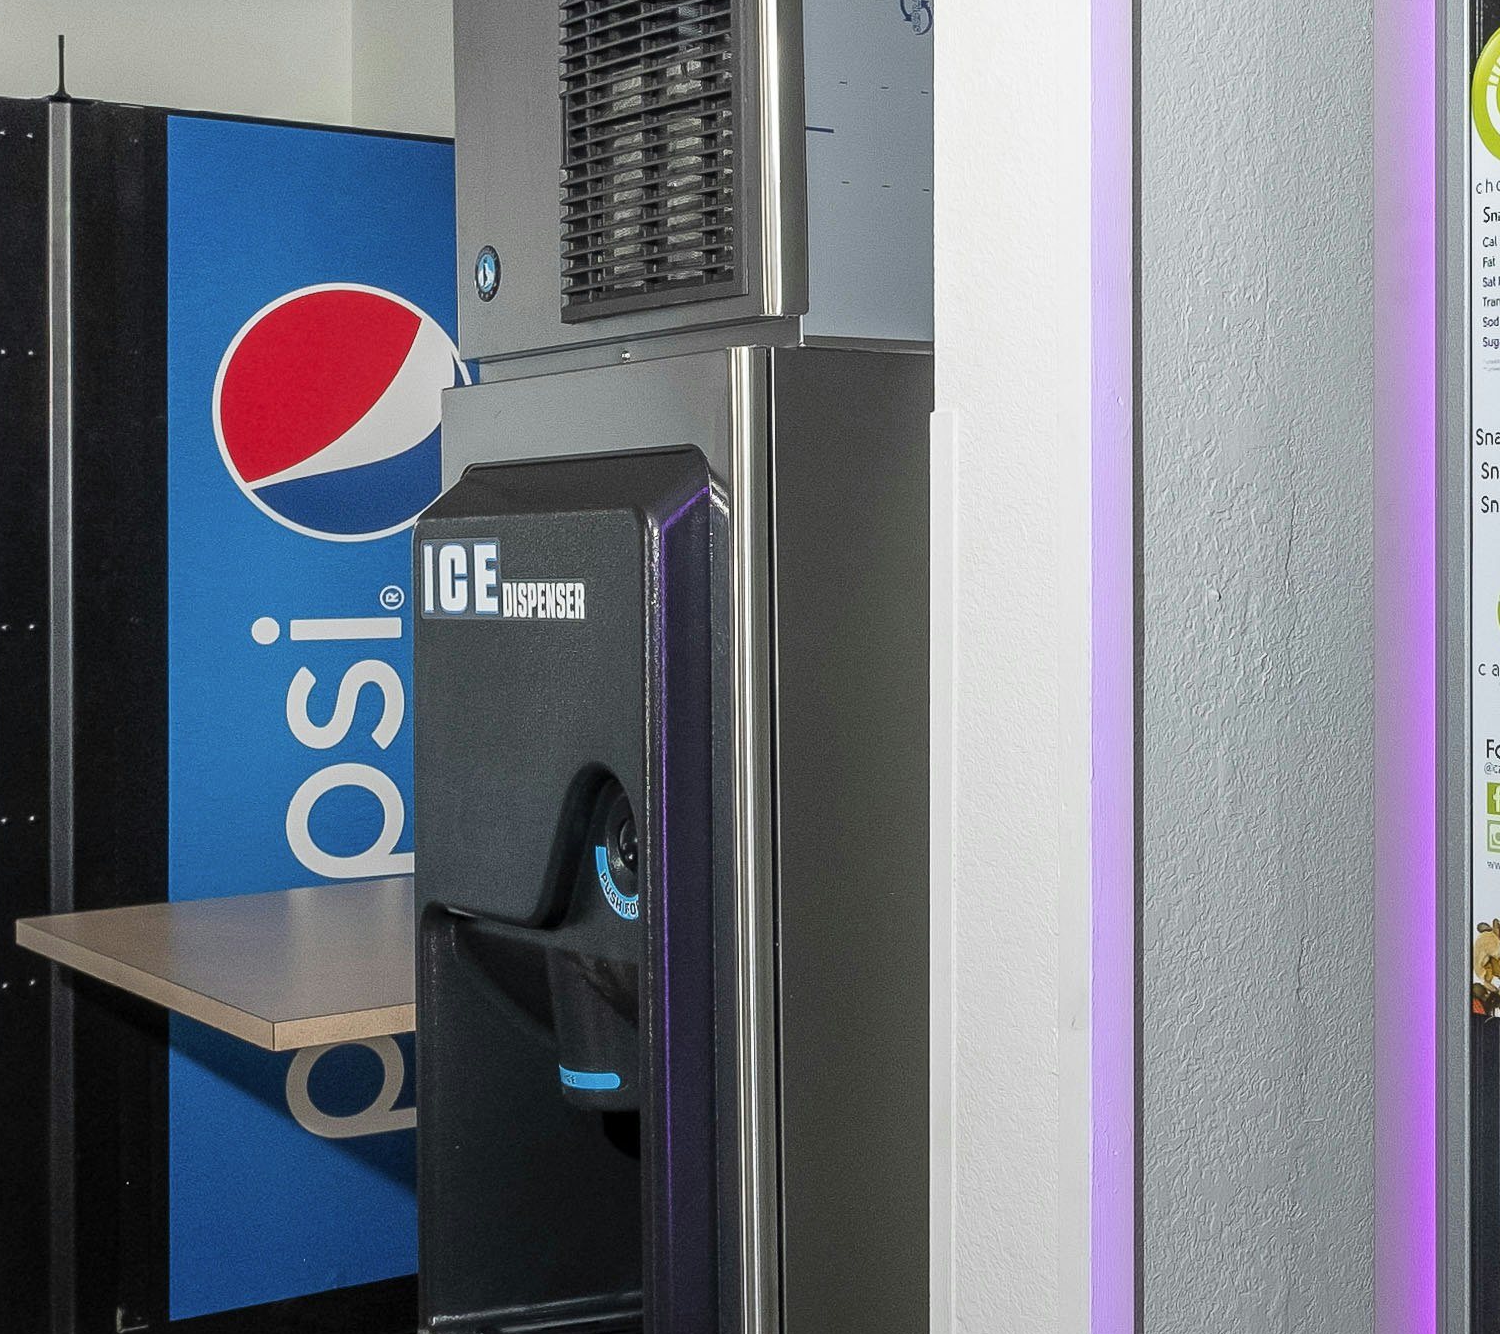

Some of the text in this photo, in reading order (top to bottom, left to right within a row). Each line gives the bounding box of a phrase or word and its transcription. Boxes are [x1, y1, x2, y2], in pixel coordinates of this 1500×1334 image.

[422, 542, 585, 619] ICE DISPENSER
[599, 871, 623, 915] PUSH
